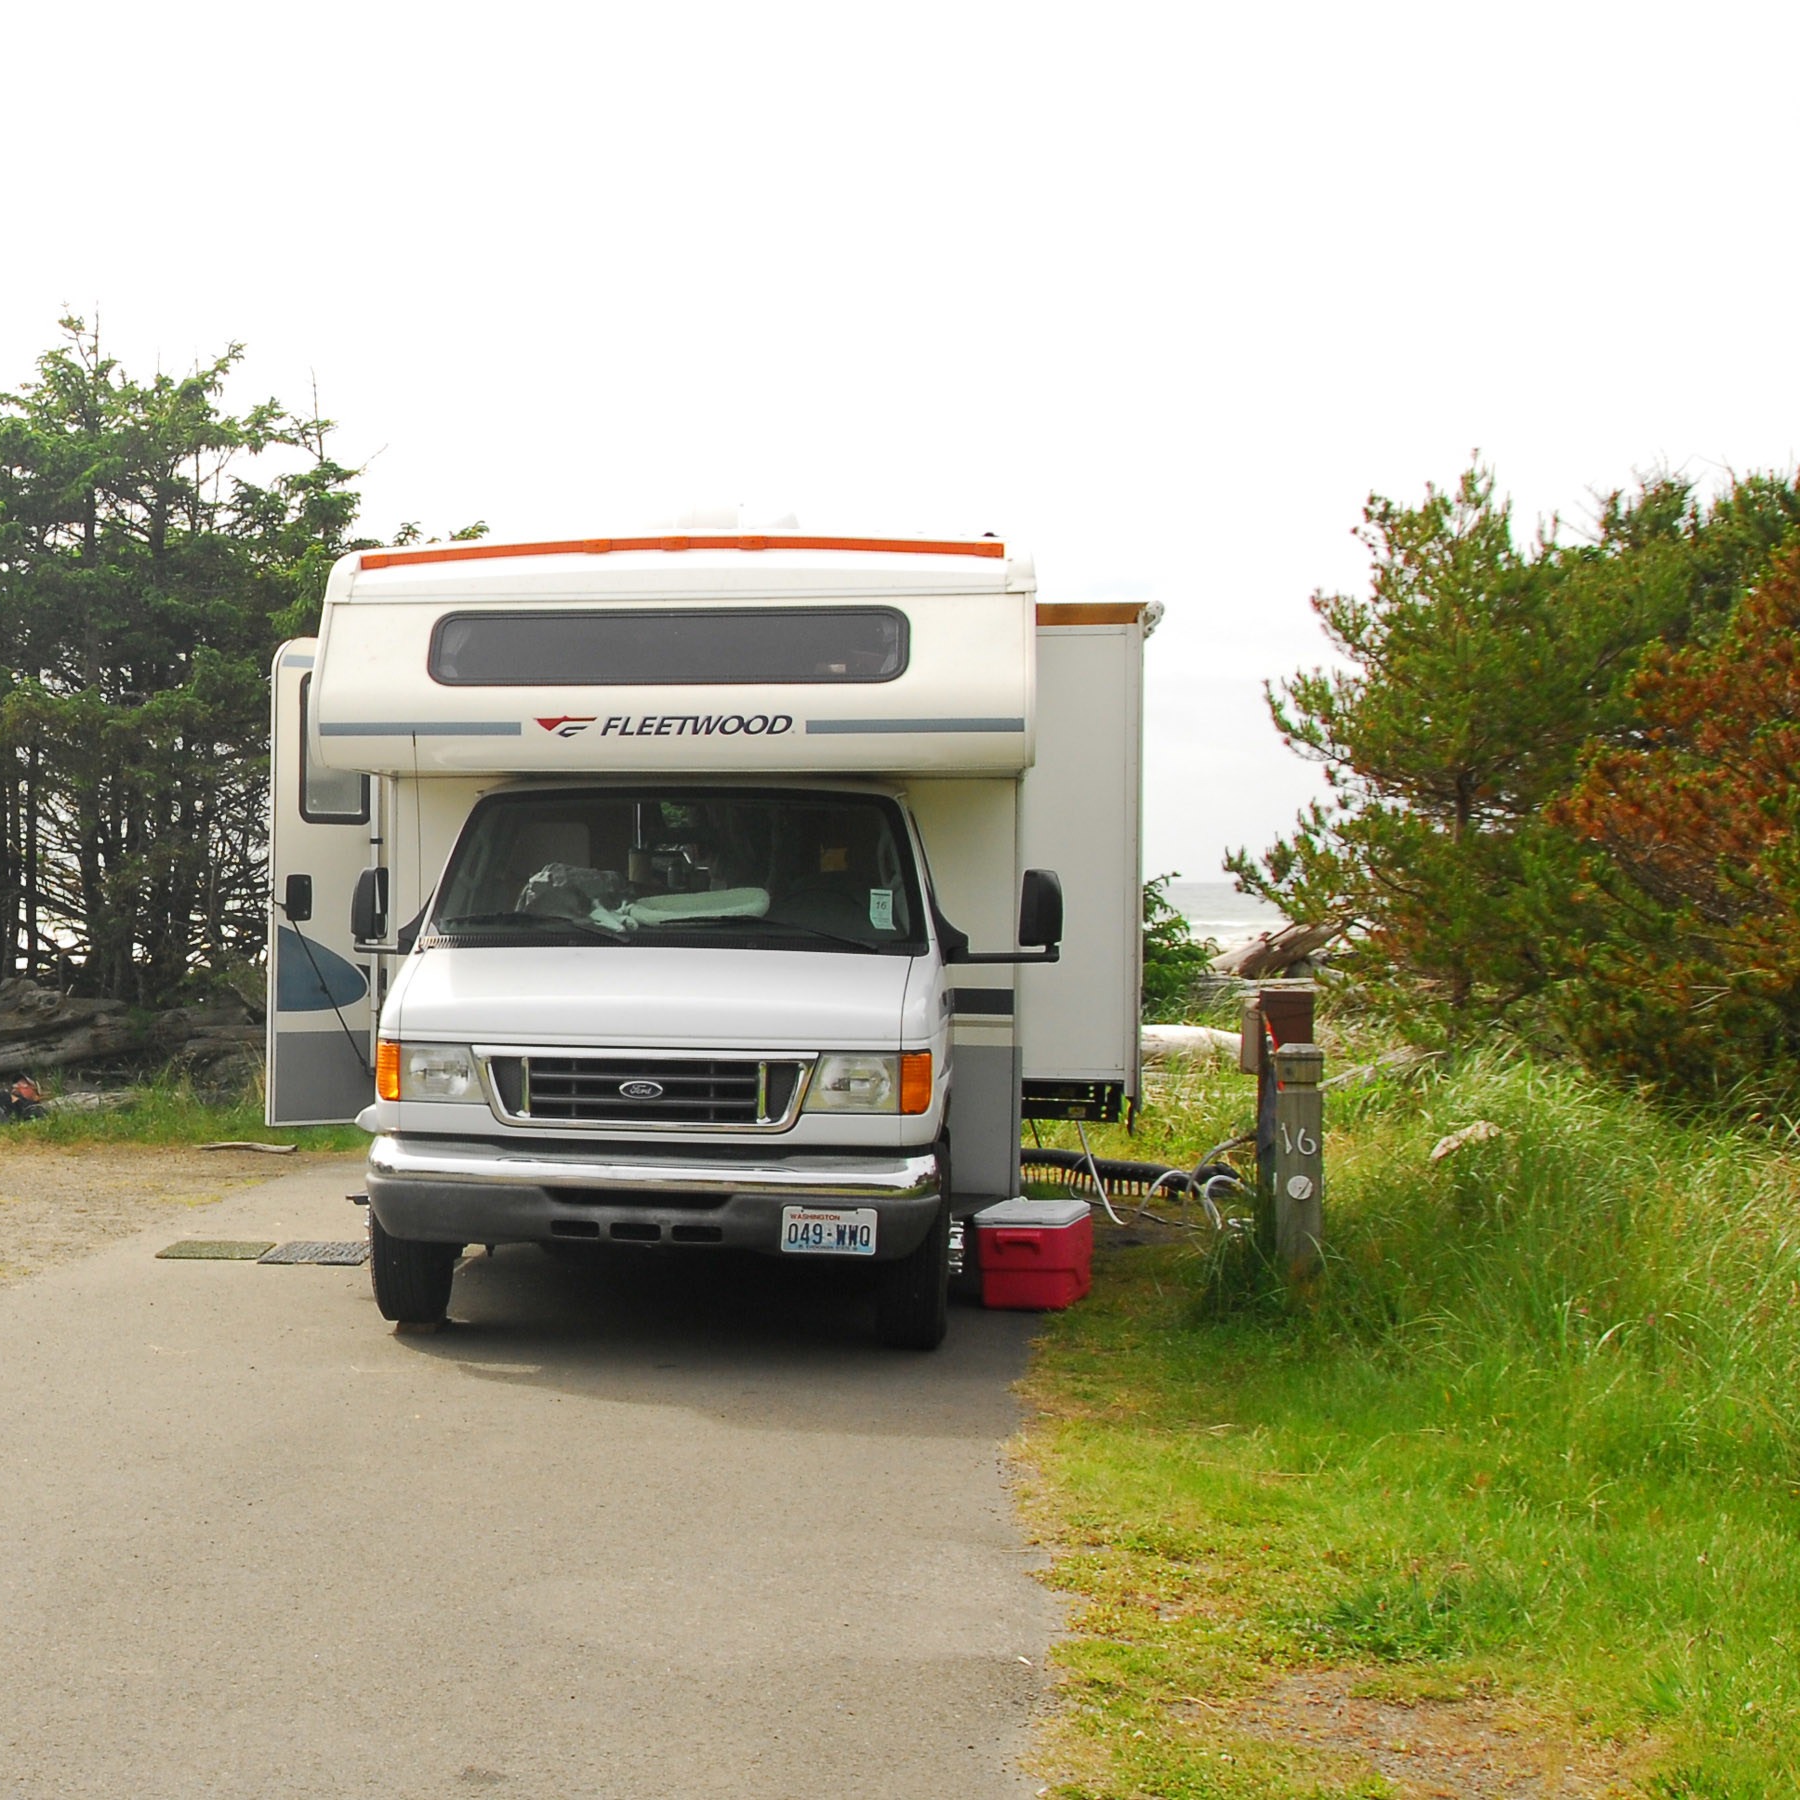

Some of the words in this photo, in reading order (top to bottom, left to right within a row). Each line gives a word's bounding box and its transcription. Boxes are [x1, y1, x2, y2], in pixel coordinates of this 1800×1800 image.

[600, 714, 793, 736] FLEETWOOD
[876, 901, 887, 910] 16
[630, 1084, 653, 1095] Ford
[1280, 1122, 1317, 1155] 16
[790, 1213, 841, 1221] WASHINGTON
